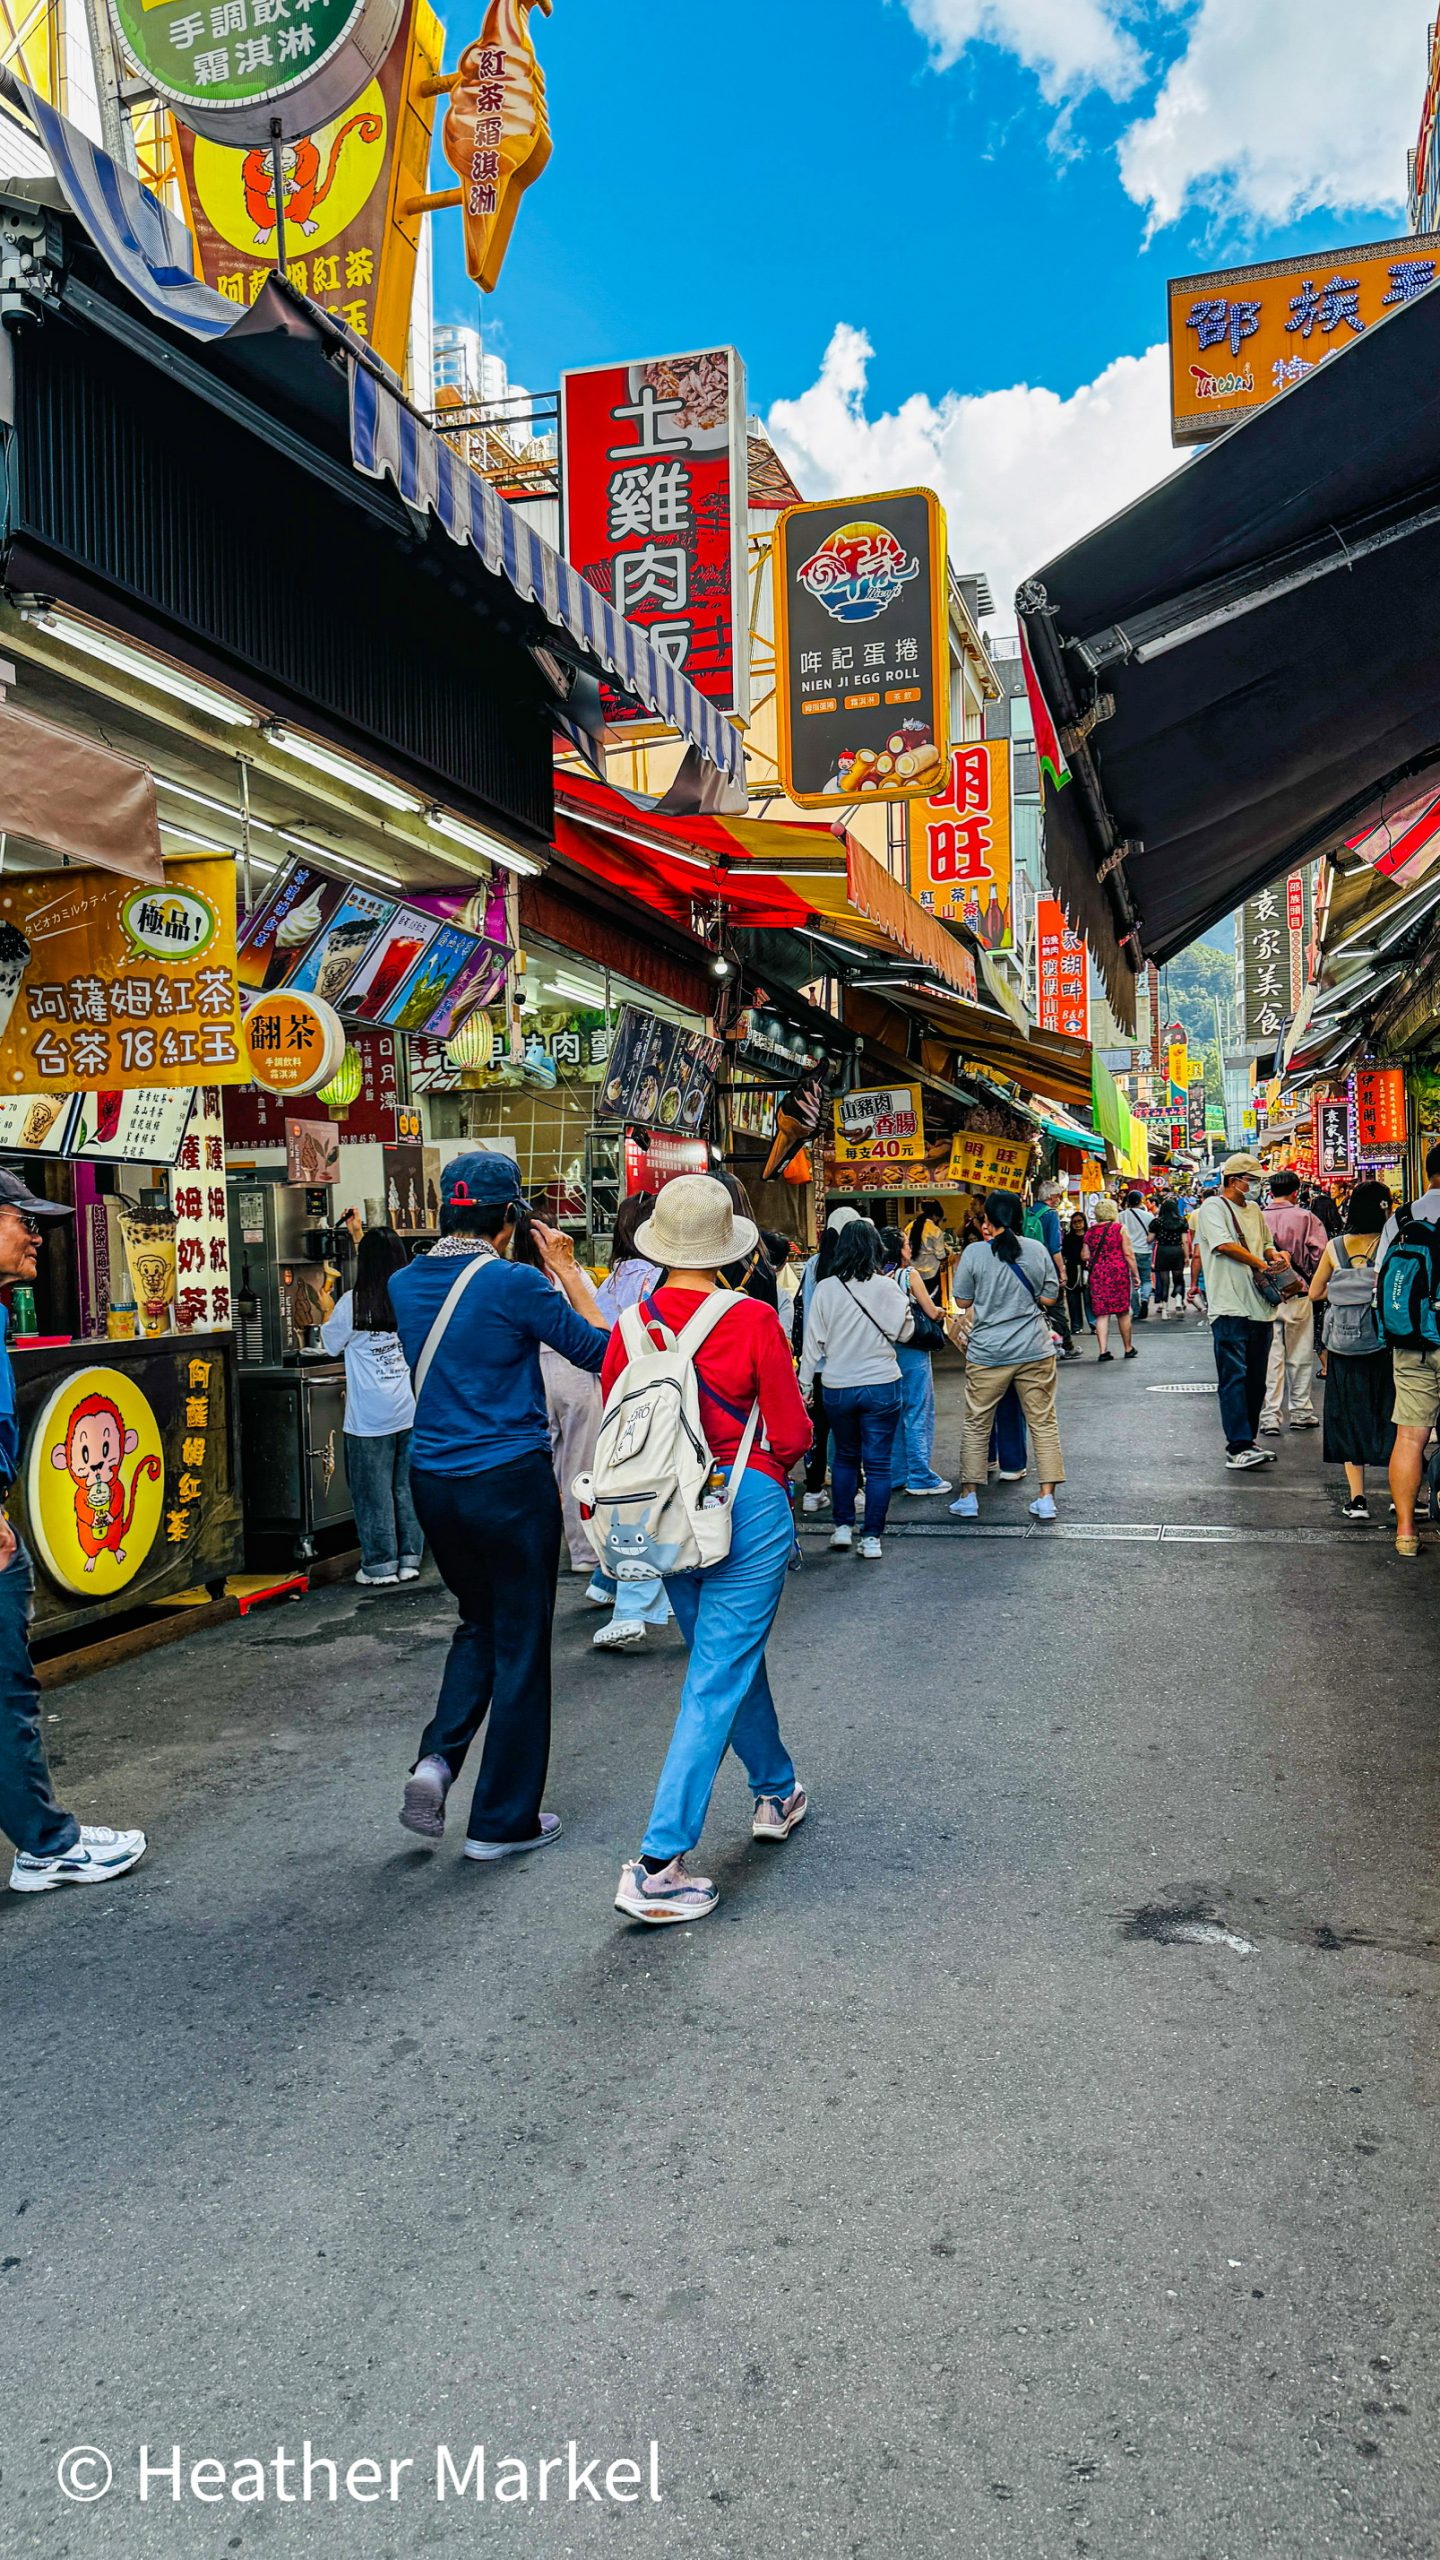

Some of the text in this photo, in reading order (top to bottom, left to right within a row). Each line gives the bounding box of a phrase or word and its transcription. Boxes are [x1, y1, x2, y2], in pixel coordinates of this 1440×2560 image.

[194, 23, 316, 86] 霜淇淋
[469, 50, 507, 215] 紅茶霜淇淋
[1272, 348, 1338, 389] 特
[800, 637, 919, 674] 哖記蛋捲
[801, 667, 920, 692] NIEN JI EGG ROLL
[928, 746, 993, 882] 明旺
[1289, 881, 1301, 927] 邵族頭目
[1062, 903, 1083, 1002] 家湖畔
[1251, 889, 1284, 1035] 袁家美食
[29, 970, 233, 1023] 阿薩姆紅茶
[250, 1014, 316, 1050] 翻茶
[441, 1029, 615, 1072] 早肉羹
[265, 1057, 302, 1067] 手調飲料
[380, 1037, 397, 1111] 日月潭
[840, 1093, 892, 1122] 山豬肉
[874, 1111, 917, 1136] 香腸
[341, 1135, 348, 1144] 50
[369, 1133, 377, 1143] 50
[845, 1140, 914, 1160] 每支40元
[965, 1141, 1018, 1165] 明旺
[175, 1106, 207, 1324] 薩姆奶茶
